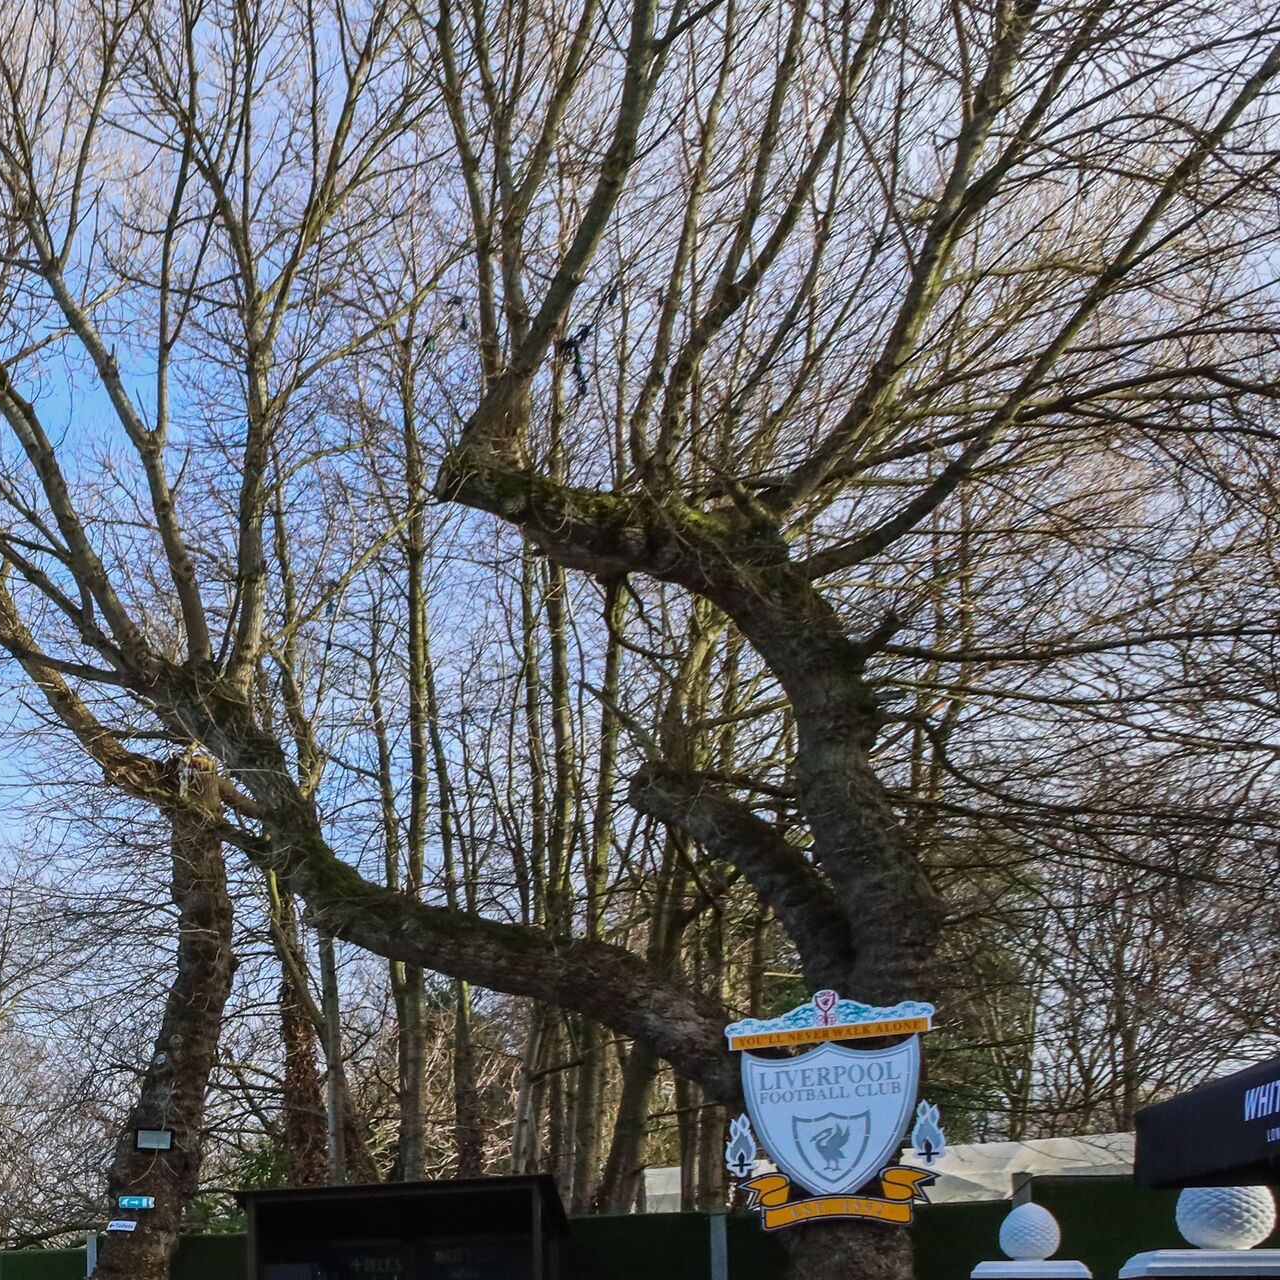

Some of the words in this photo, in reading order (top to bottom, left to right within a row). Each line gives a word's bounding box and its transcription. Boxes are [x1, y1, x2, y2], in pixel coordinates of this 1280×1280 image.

[786, 1030, 831, 1043] NEVER
[832, 1025, 871, 1039] WALK
[876, 1020, 922, 1033] ALONE
[758, 1060, 902, 1092] LIVERPOOL
[759, 1086, 851, 1106] FOOTBALL
[855, 1081, 902, 1098] CLUB
